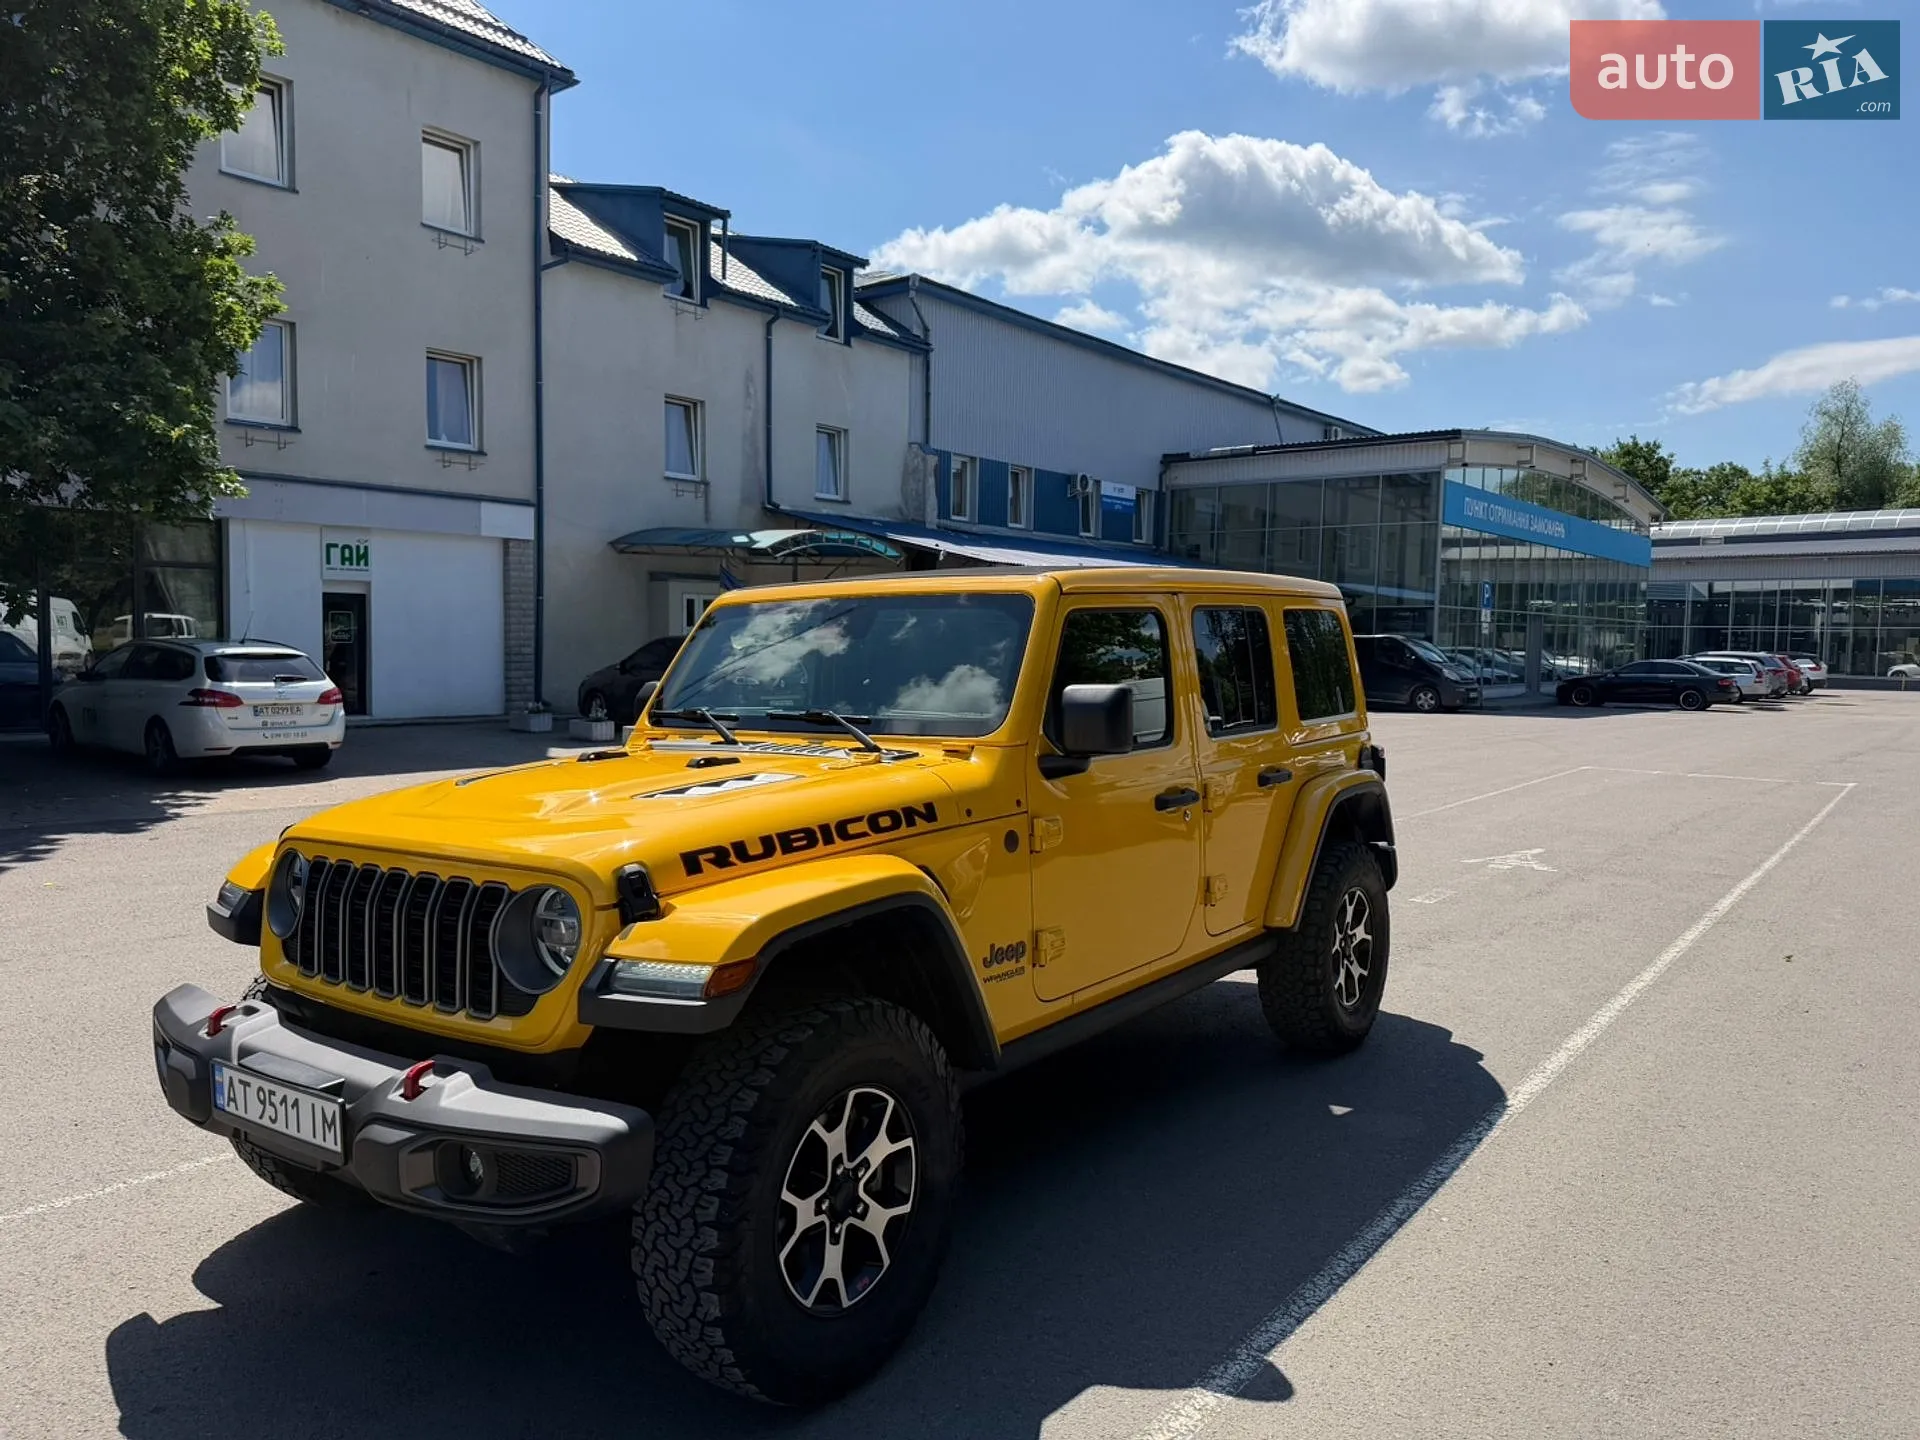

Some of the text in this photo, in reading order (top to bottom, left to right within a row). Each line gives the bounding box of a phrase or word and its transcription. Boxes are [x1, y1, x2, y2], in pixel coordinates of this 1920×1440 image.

[1463, 497, 1489, 520] ПУНКТ
[325, 538, 369, 567] ГАЙ
[679, 801, 939, 877] RUBICON
[982, 940, 1026, 968] Jeep
[227, 1076, 339, 1147] AT 9511 IM
